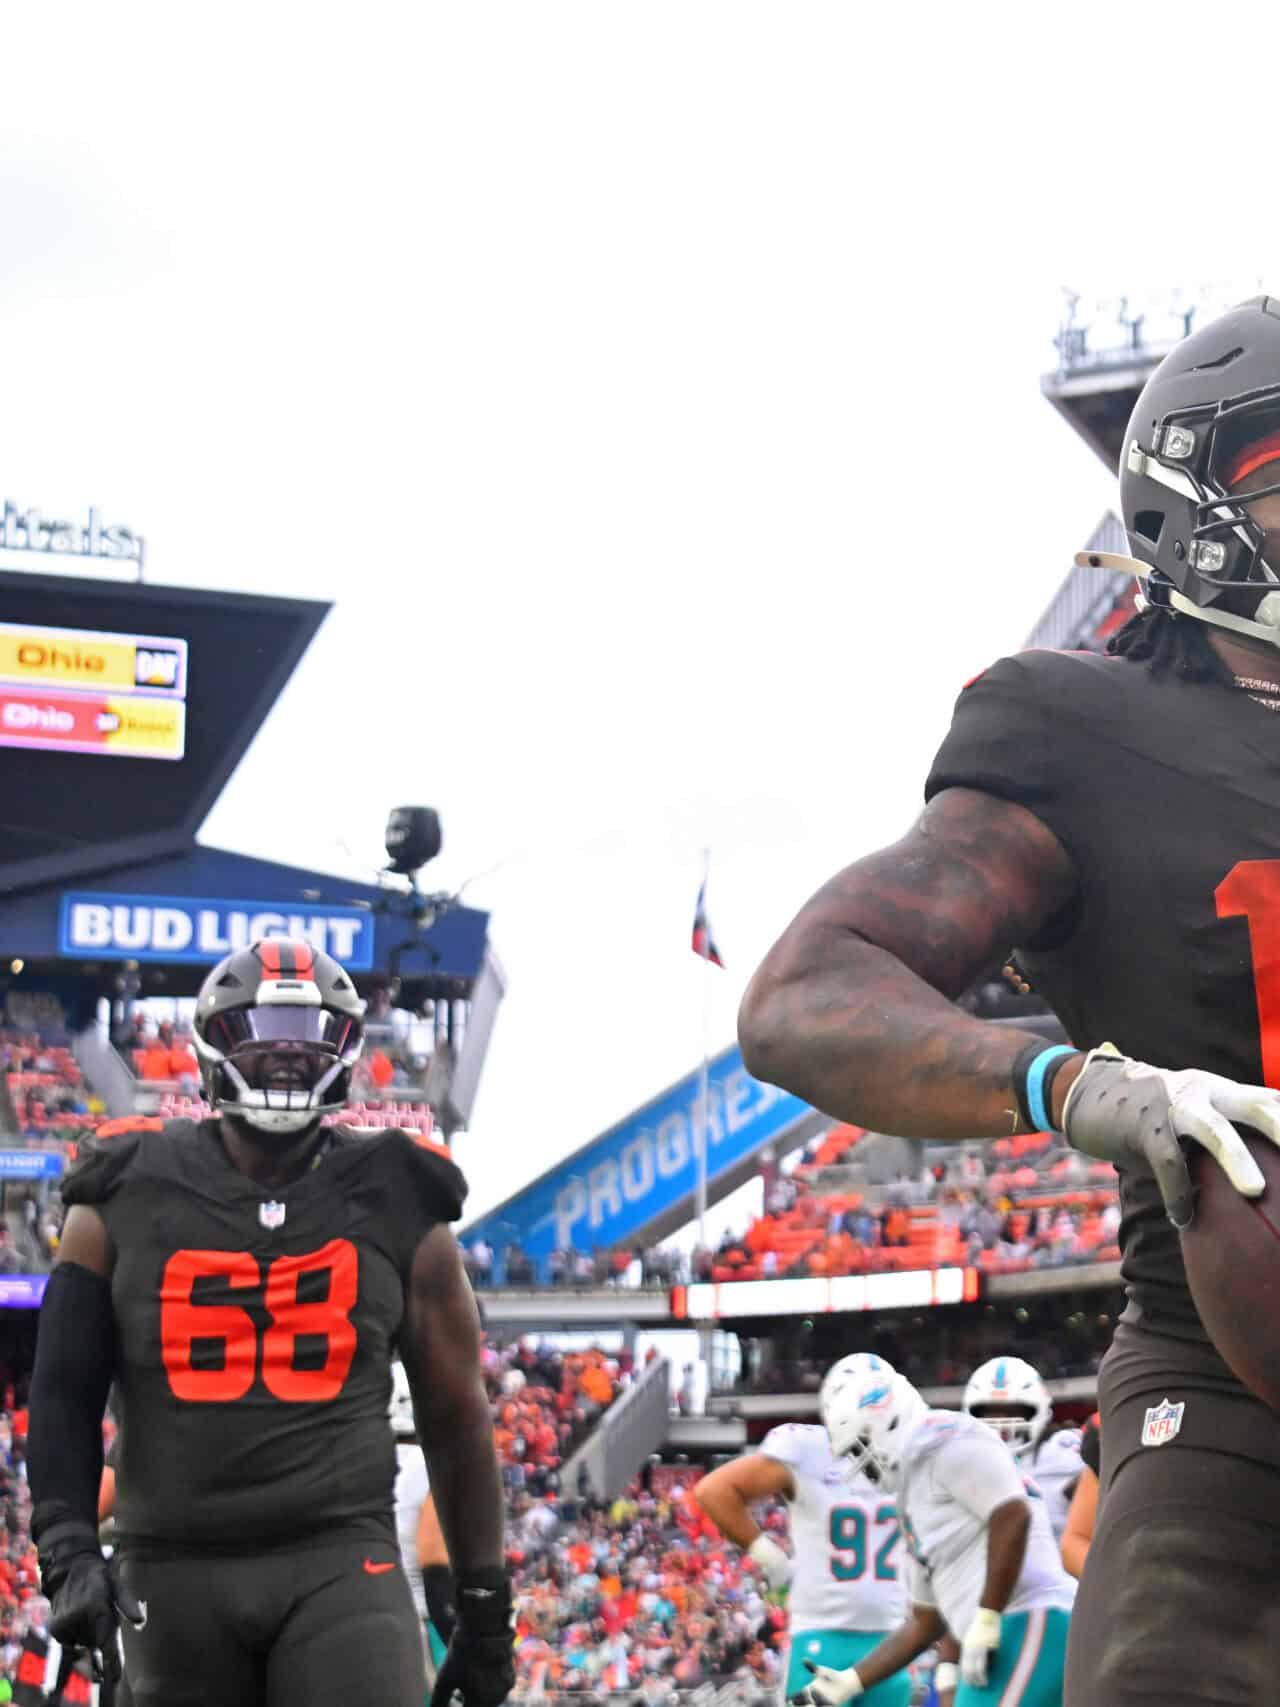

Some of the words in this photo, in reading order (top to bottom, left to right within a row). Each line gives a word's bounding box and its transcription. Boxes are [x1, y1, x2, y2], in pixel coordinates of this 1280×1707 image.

[17, 643, 106, 673] Ohio
[72, 903, 194, 951] BUD
[198, 909, 362, 959] LIGHT
[555, 1066, 798, 1252] PROGRES
[160, 1238, 358, 1403] 68
[829, 1501, 898, 1583] 92
